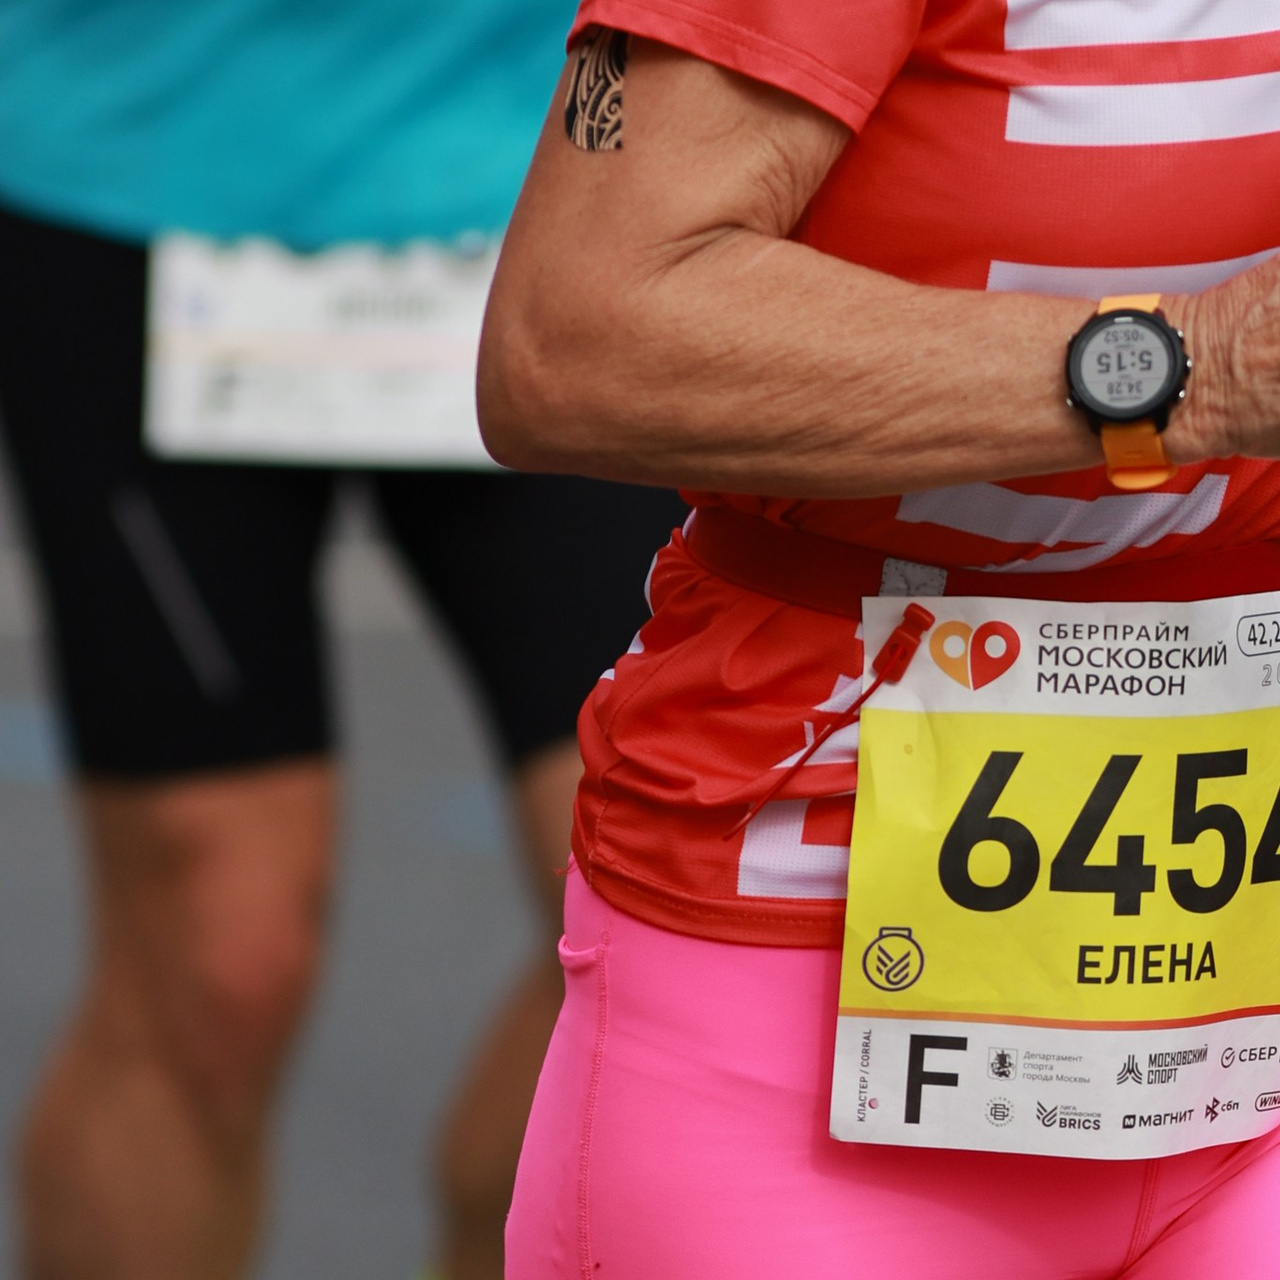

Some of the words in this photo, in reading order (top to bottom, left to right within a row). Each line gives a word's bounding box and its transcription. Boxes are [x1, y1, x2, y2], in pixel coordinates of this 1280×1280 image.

[1096, 350, 1153, 374] 5:15
[1038, 621, 1190, 643] СБЕРПРАЙМ
[1037, 640, 1228, 669] МОСКОВСКИЙ
[1036, 672, 1186, 697] МАРАФОН
[1076, 939, 1218, 986] ЕЛЕНА
[861, 1029, 872, 1068] CORRAL
[1023, 1051, 1083, 1062] Департамент
[1148, 1043, 1208, 1068] МОСКОВСКИЙ
[1238, 1046, 1278, 1062] СБЕР
[1022, 1072, 1053, 1082] города
[1055, 1074, 1091, 1083] Москвы
[1023, 1062, 1054, 1072] спорта
[1147, 1068, 1178, 1085] СПОРТ
[904, 1033, 968, 1125] F
[857, 1076, 868, 1122] КЛАСТЕР
[1220, 1100, 1240, 1112] сбп
[1059, 1117, 1101, 1131] BRICS
